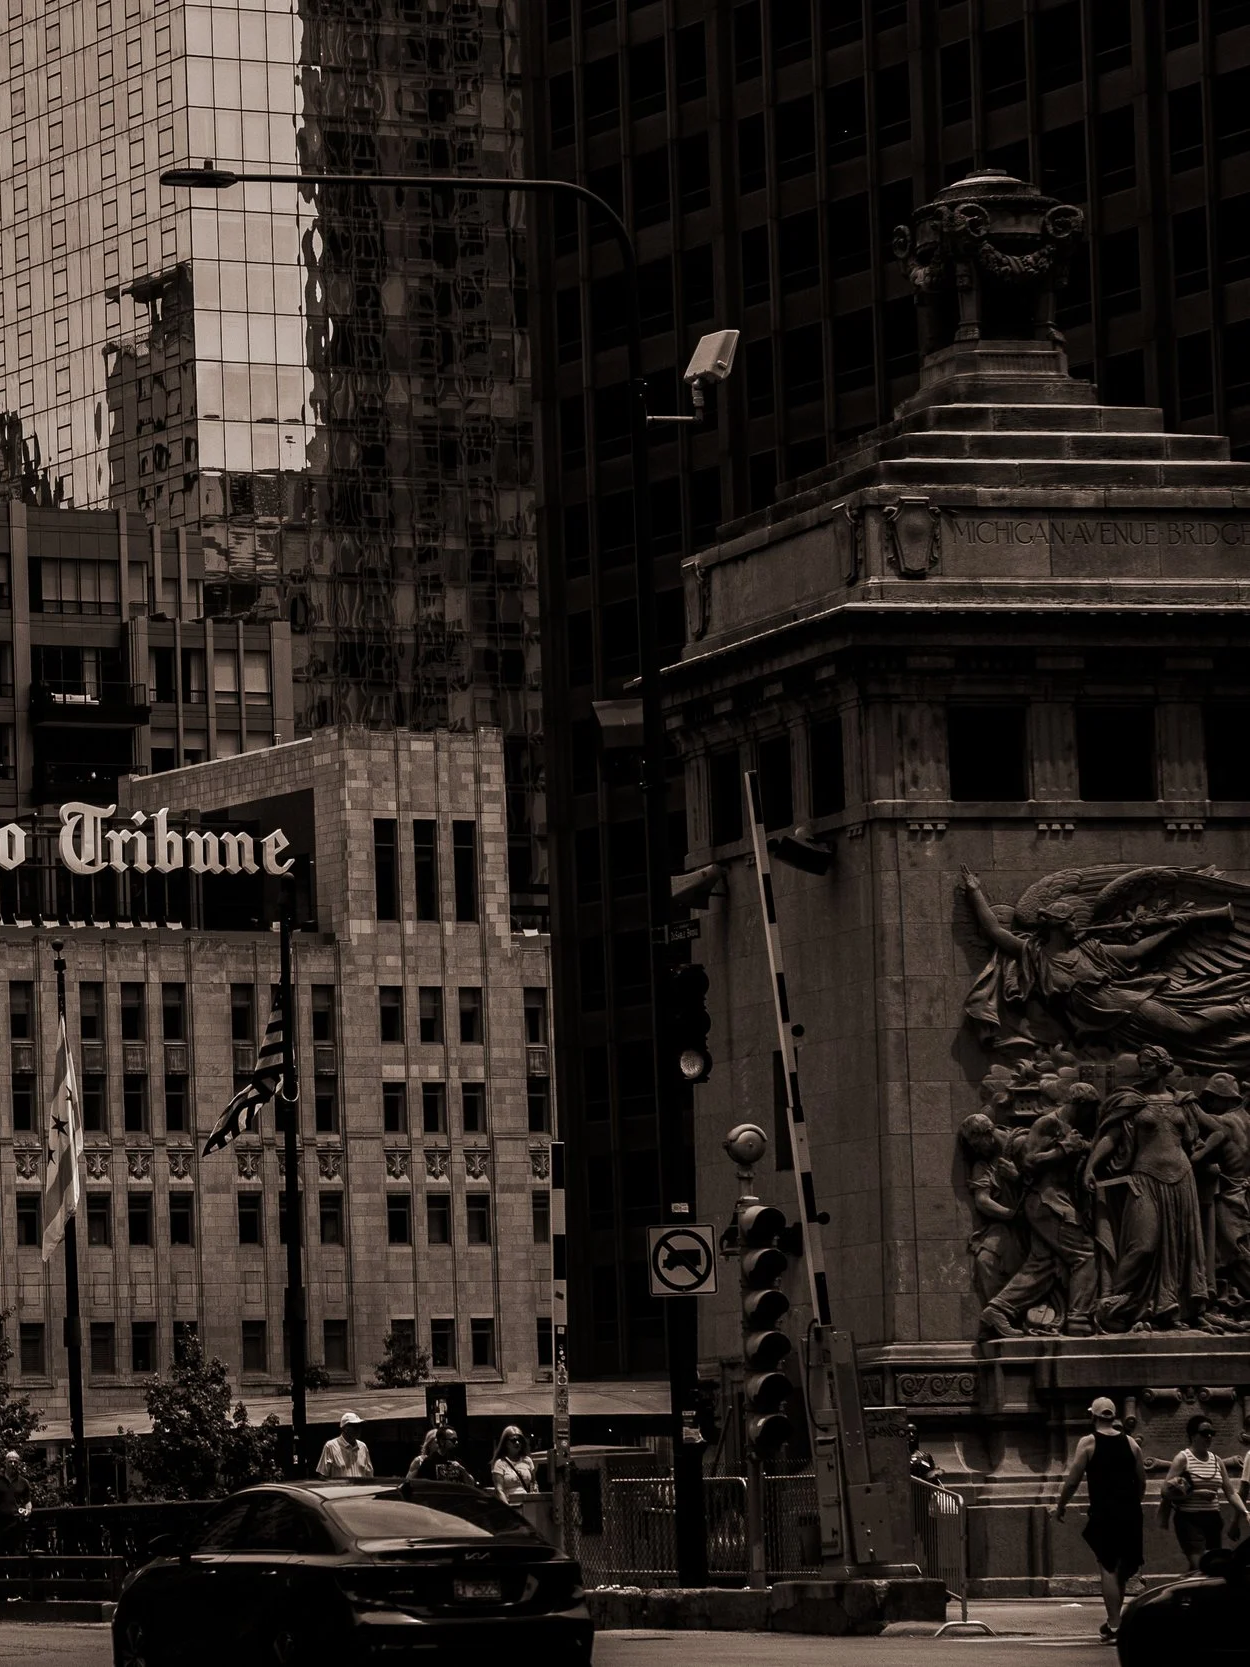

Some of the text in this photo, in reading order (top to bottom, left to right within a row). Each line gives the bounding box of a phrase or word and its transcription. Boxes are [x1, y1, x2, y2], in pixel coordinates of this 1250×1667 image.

[952, 521, 1066, 545] MICHIGAN
[1070, 522, 1159, 545] AVENUE
[59, 801, 296, 875] Tribune
